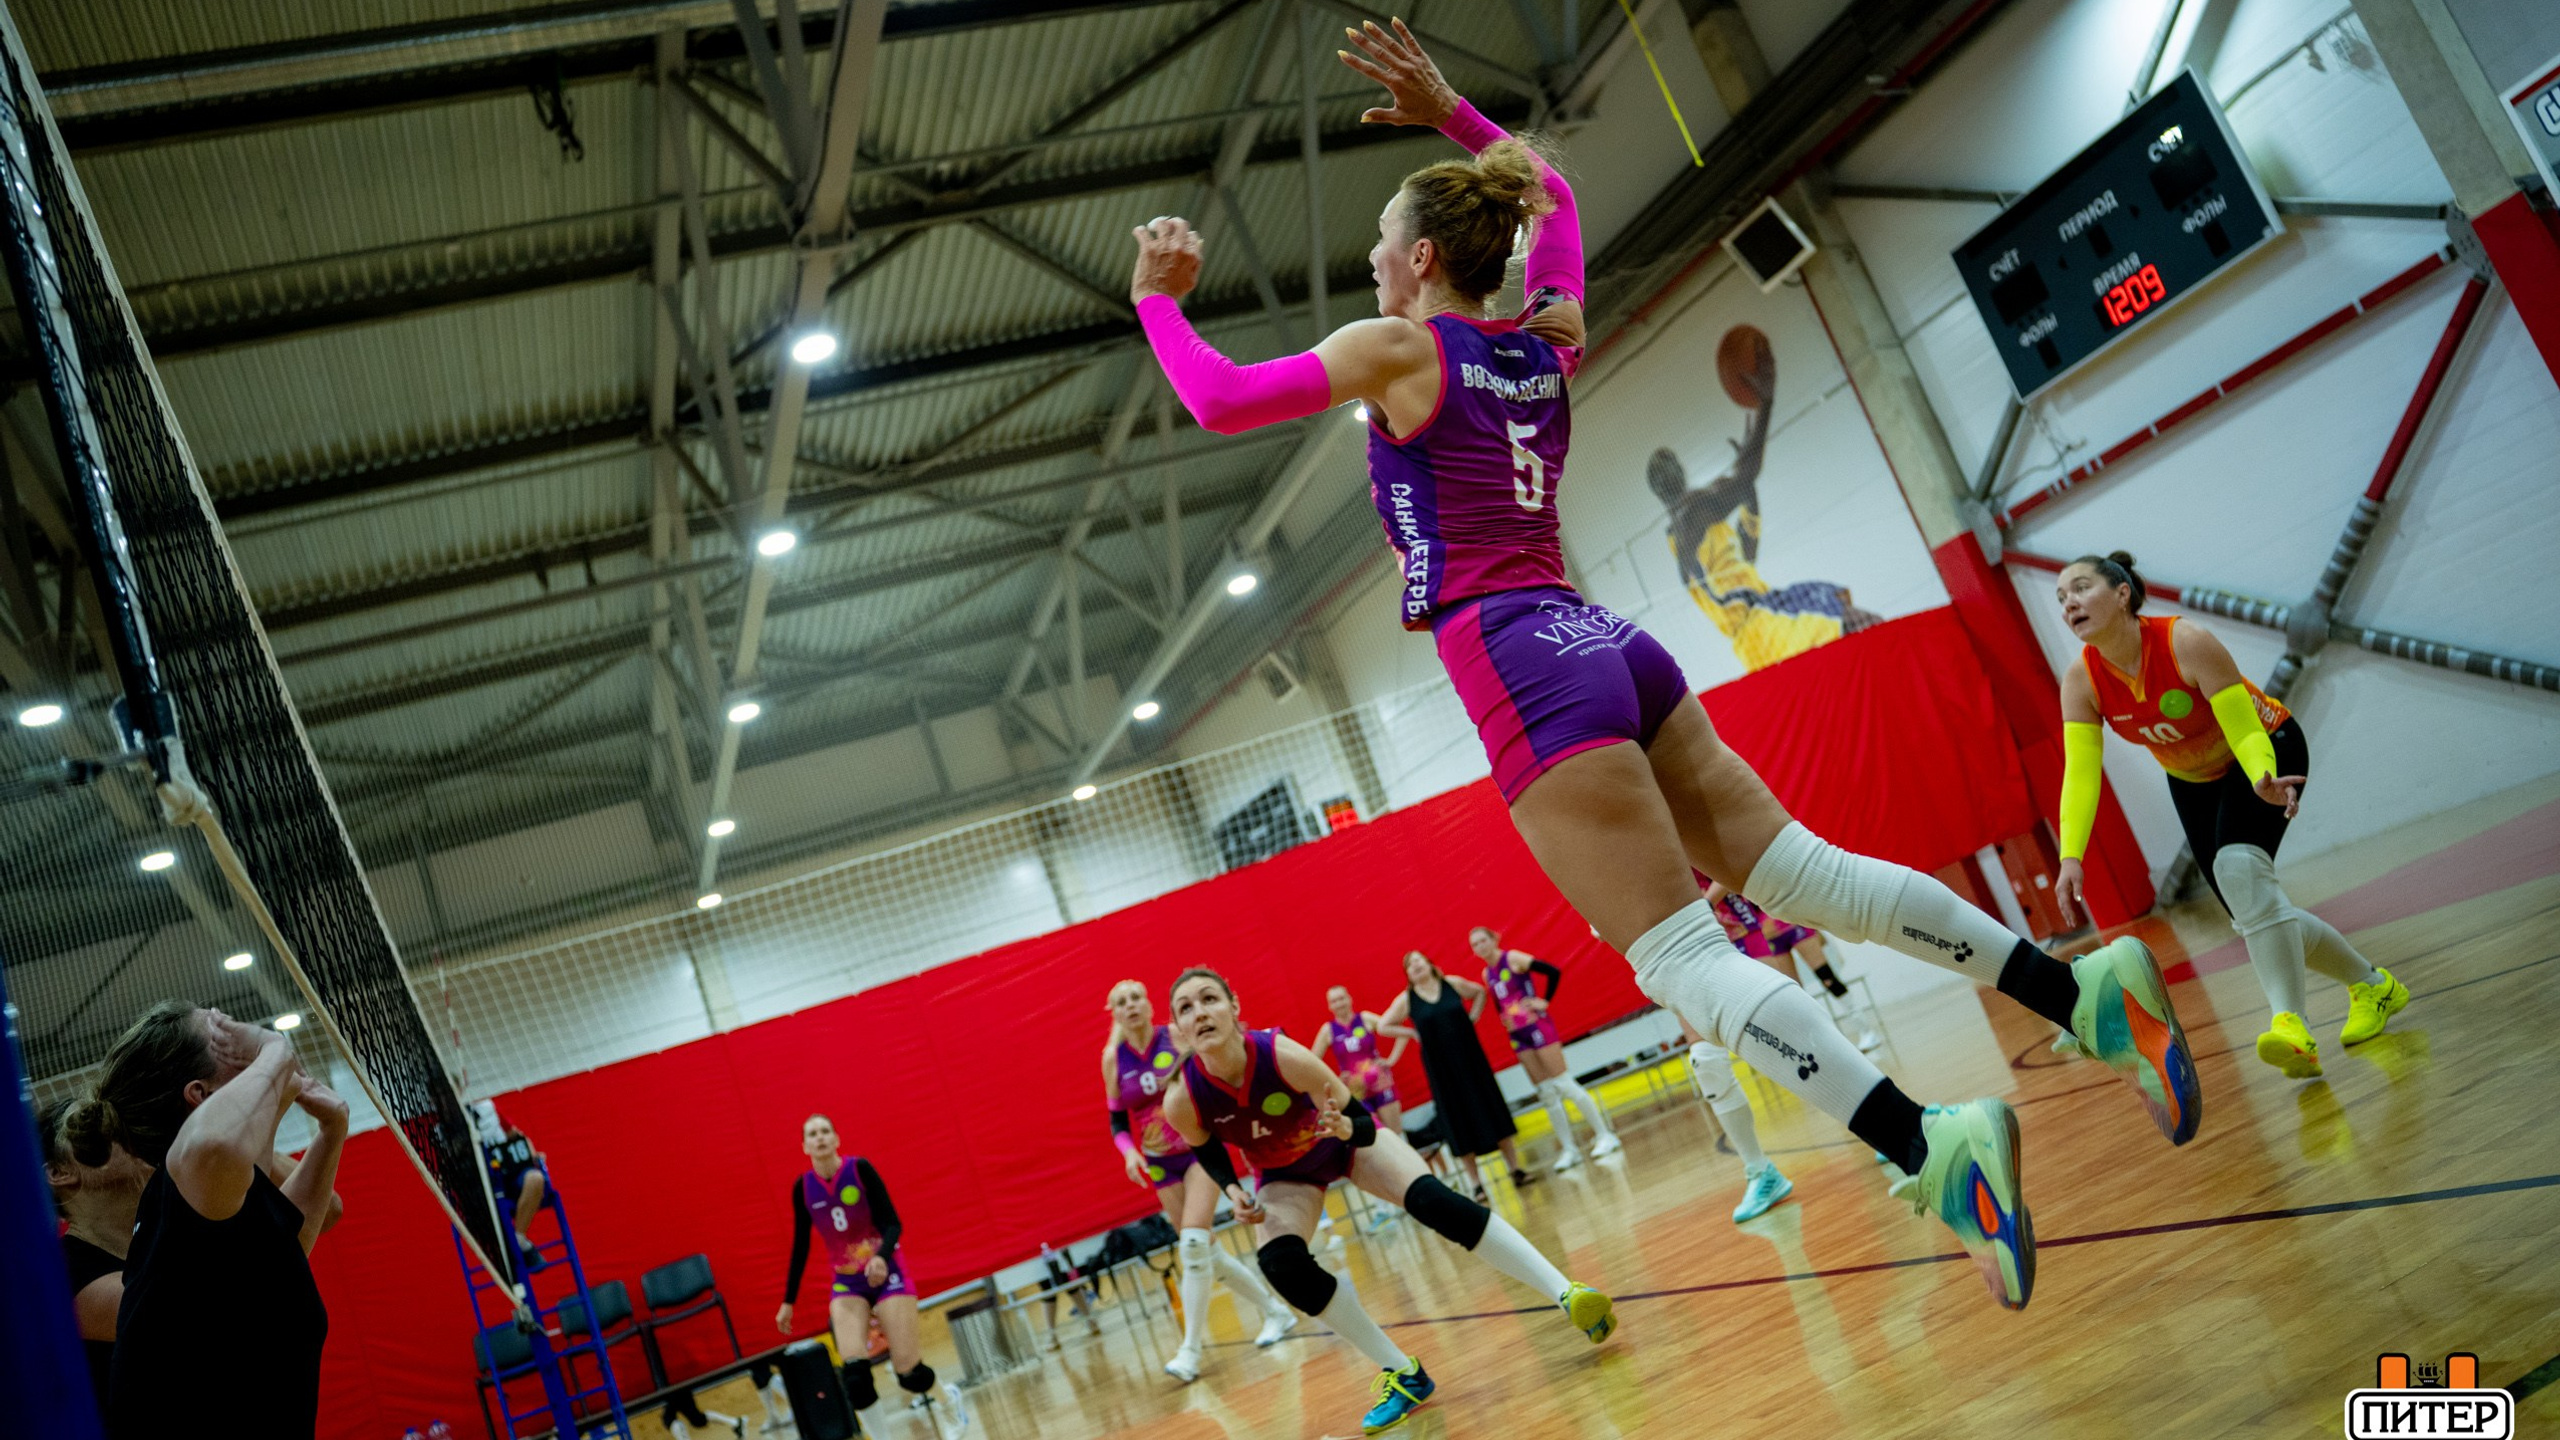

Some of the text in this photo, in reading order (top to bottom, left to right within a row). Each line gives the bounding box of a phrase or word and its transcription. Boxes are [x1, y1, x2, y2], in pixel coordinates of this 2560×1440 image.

[2059, 190, 2119, 243] ПЕРИОД
[2182, 194, 2227, 234] ФОЛЫ
[2092, 252, 2142, 297] ВРЕМЯ
[2019, 313, 2059, 347] ФОЛЫ
[1506, 419, 1545, 512] 5
[2138, 722, 2185, 745] 10
[1139, 1071, 1156, 1095] 9
[831, 1206, 849, 1232] 8
